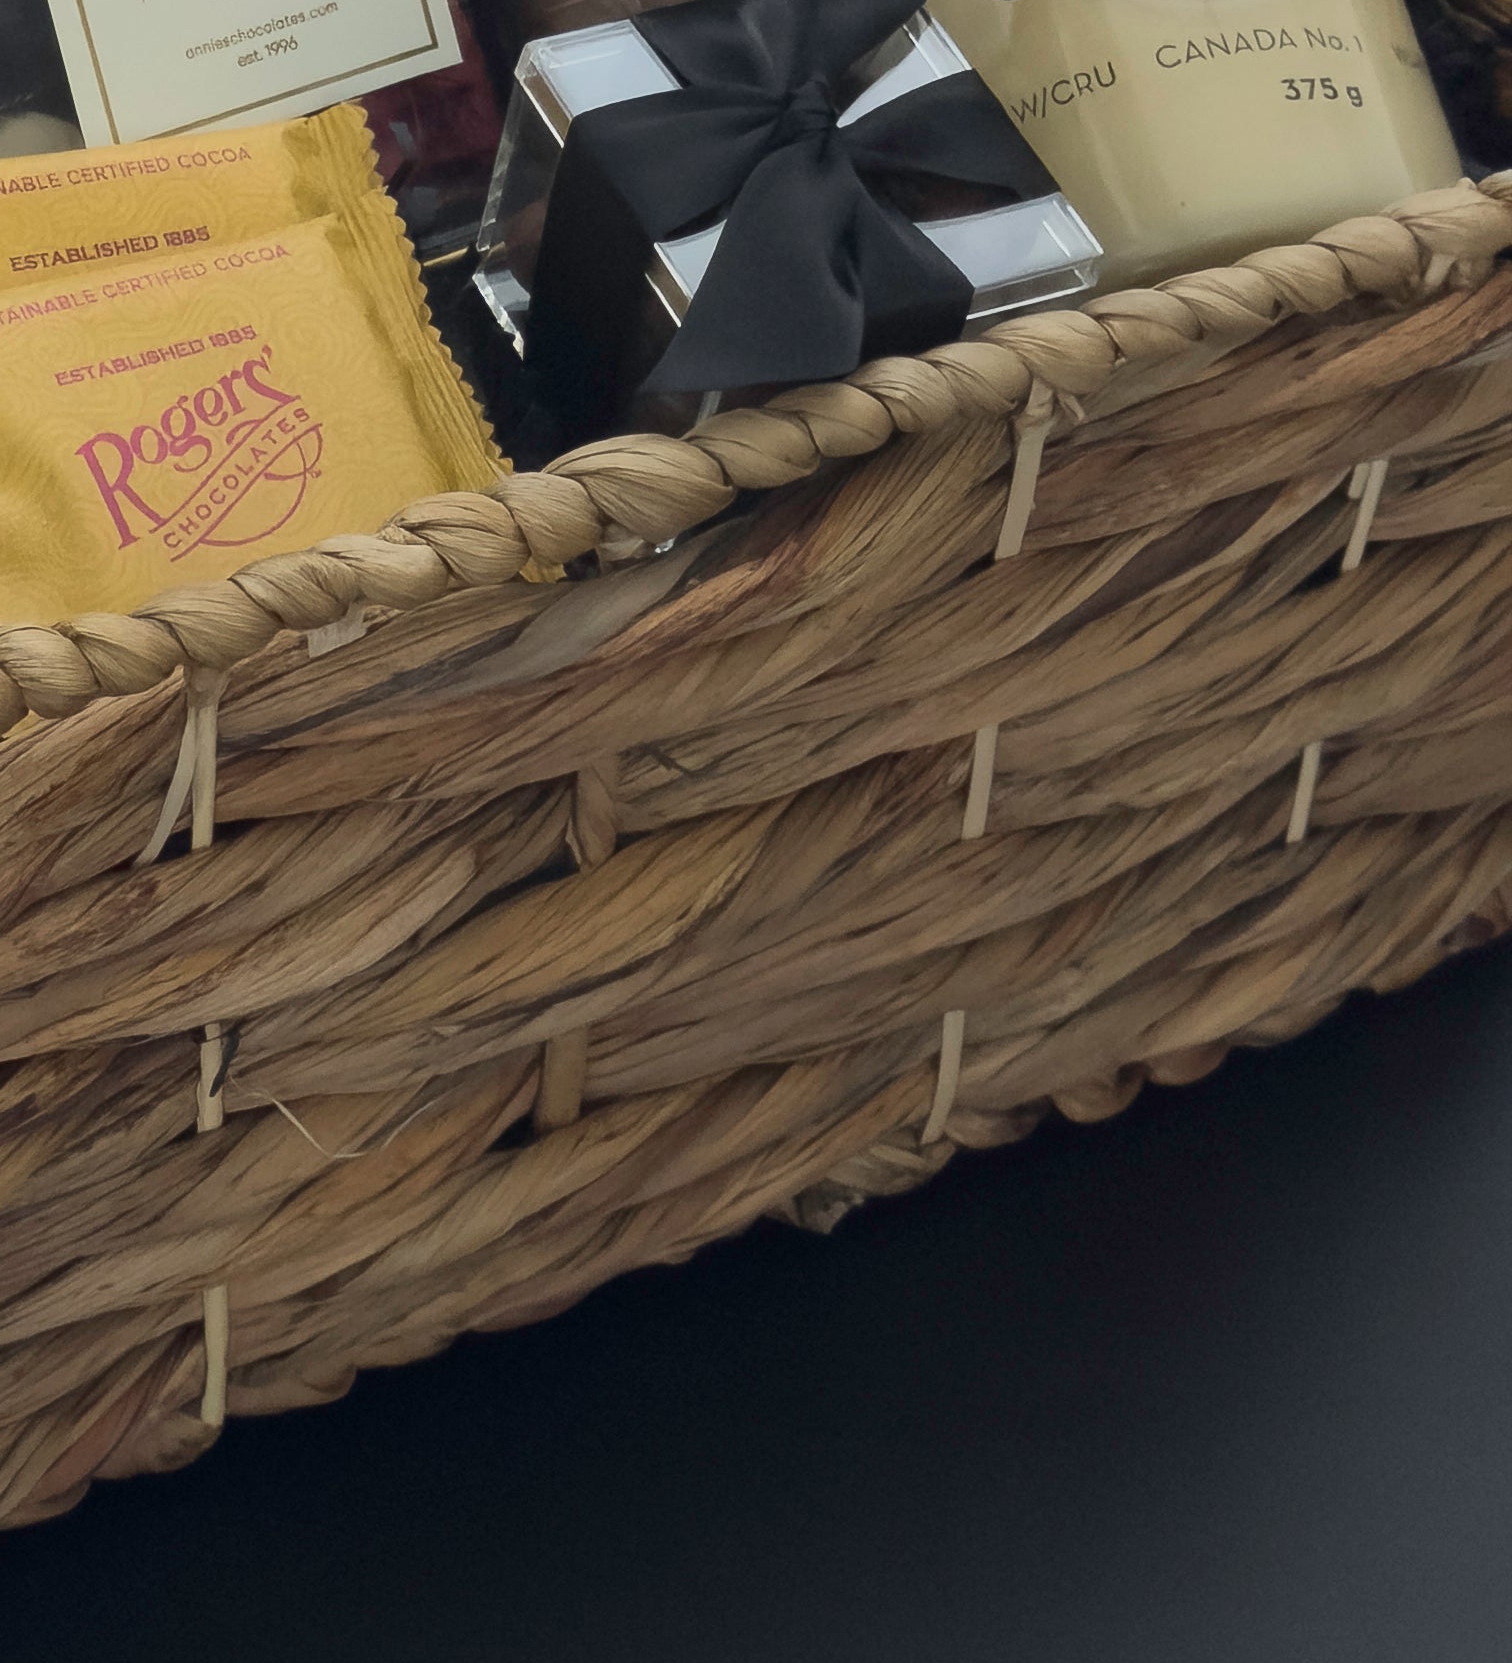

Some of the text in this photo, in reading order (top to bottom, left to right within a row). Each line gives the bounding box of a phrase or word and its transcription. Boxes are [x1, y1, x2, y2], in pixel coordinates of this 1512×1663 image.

[185, 1, 338, 59] annieschocolates.com
[264, 35, 299, 58] 1996
[1156, 28, 1297, 68] CANADA
[1304, 27, 1349, 52] No.
[1011, 61, 1117, 124] W/CRU
[1281, 77, 1363, 107] 375 g
[67, 157, 170, 186] CERTIFIED
[177, 146, 253, 170] COCOA
[9, 225, 211, 272] ESTABLISHED 1885
[102, 262, 208, 299] CERTIFIED
[213, 244, 291, 272] COCOA
[54, 324, 257, 387] ESTABLISHED 1885
[162, 407, 310, 549] CHOCOLATES
